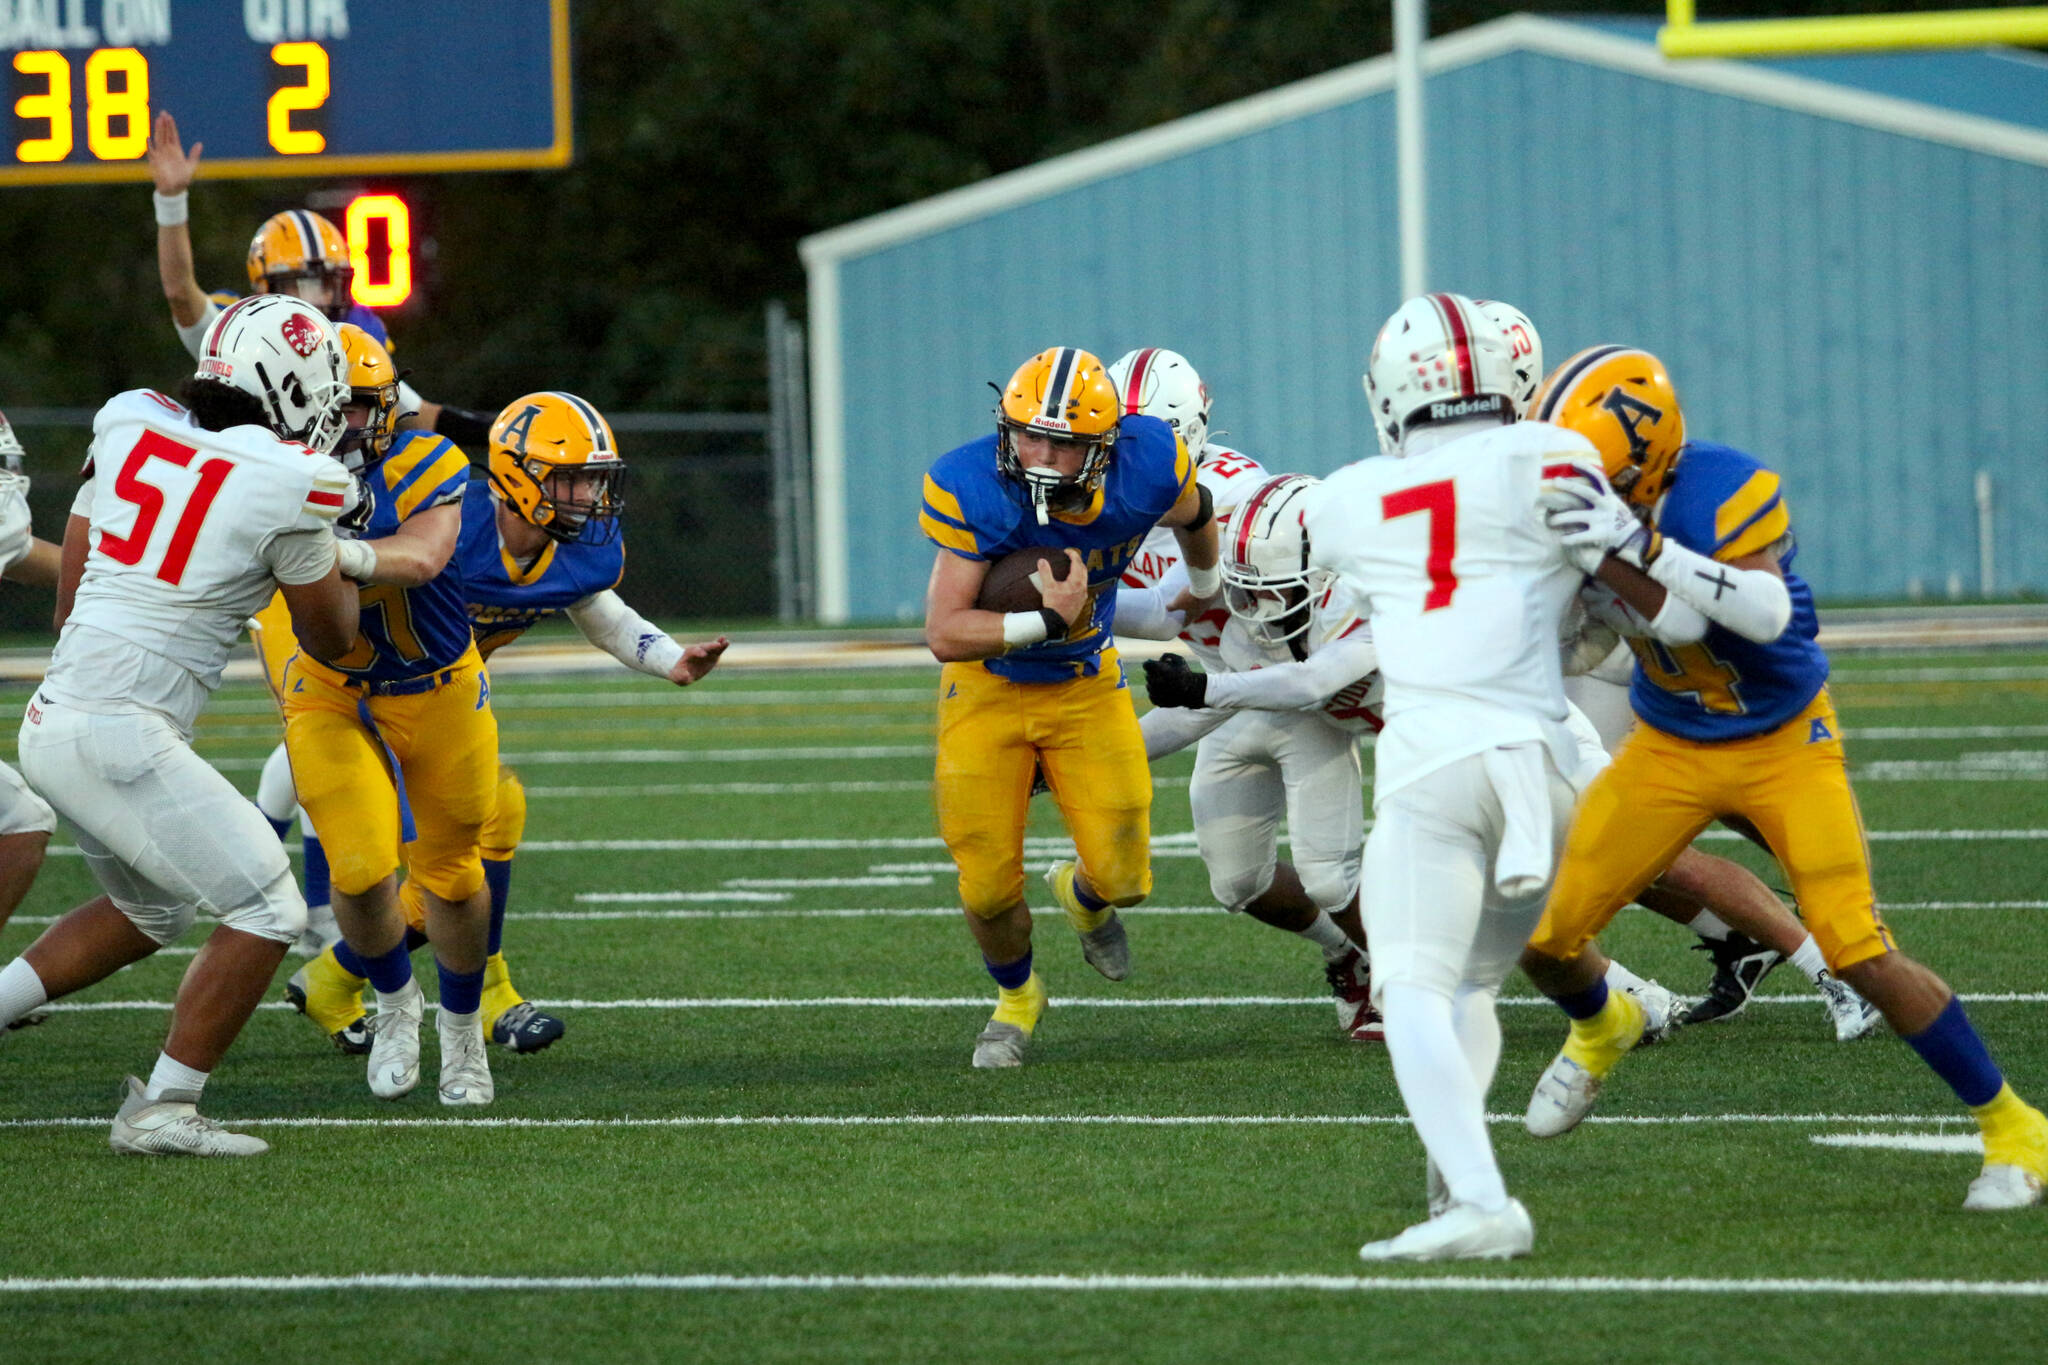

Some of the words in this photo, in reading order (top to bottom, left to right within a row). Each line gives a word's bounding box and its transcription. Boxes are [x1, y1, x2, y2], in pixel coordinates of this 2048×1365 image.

[13, 48, 149, 162] 38
[267, 42, 329, 154] 2
[346, 195, 411, 306] 0
[499, 405, 541, 456] A
[1035, 417, 1067, 429] Riddell
[1201, 452, 1259, 479] 25
[1602, 386, 1663, 465] A
[97, 428, 237, 588] 51
[1380, 477, 1459, 612] 7
[1805, 716, 1833, 744] A
